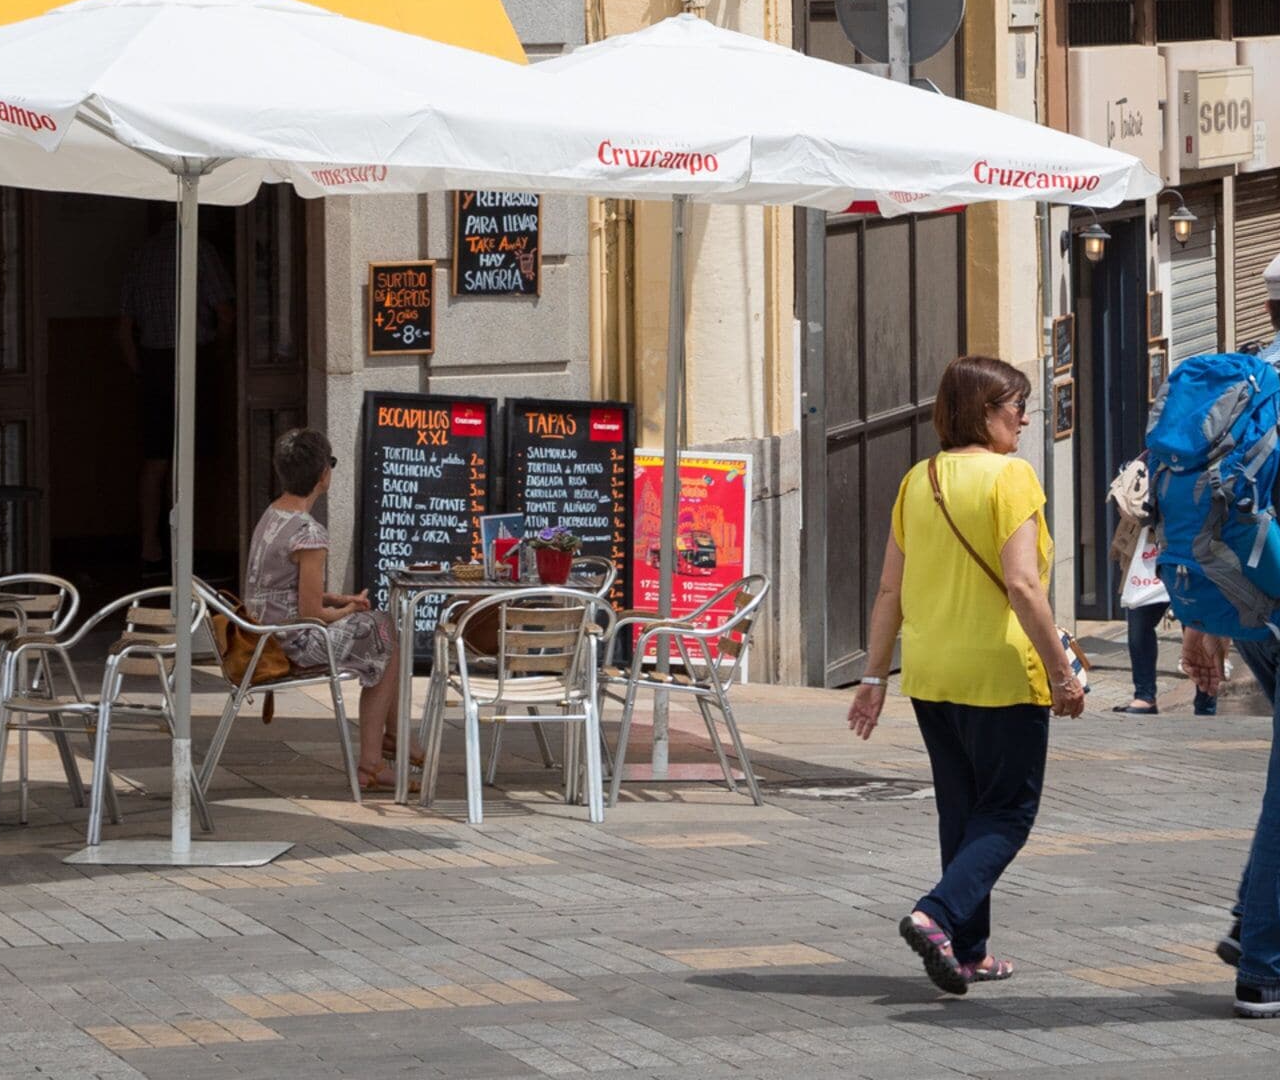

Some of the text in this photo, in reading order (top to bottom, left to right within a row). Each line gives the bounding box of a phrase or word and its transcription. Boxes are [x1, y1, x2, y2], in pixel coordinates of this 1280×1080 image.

[597, 139, 719, 176] Cruzcampo
[973, 160, 1101, 193] Cruzcampo
[465, 215, 498, 235] PARA
[479, 253, 506, 267] HAY
[377, 270, 428, 288] SURTIDO
[464, 263, 524, 291] SANGRÍA
[378, 407, 450, 430] BOCADILLOS
[525, 412, 577, 435] TAPAS
[416, 430, 449, 446] XXL
[382, 446, 425, 463] TORTILLA
[527, 446, 578, 460] SALMOREJO
[382, 461, 442, 478] SALCHICHAS
[527, 462, 562, 474] TORTILLA
[573, 462, 604, 474] PATATAS
[382, 478, 418, 494] BACON
[526, 475, 564, 487] ENSALADA
[429, 496, 467, 512] TOMATE
[525, 500, 598, 513] TOMATE ALIÑADO
[379, 510, 416, 526] JAMÓN
[380, 527, 408, 541] LOMO
[423, 530, 451, 544] ORZA
[378, 542, 413, 557] QUESO
